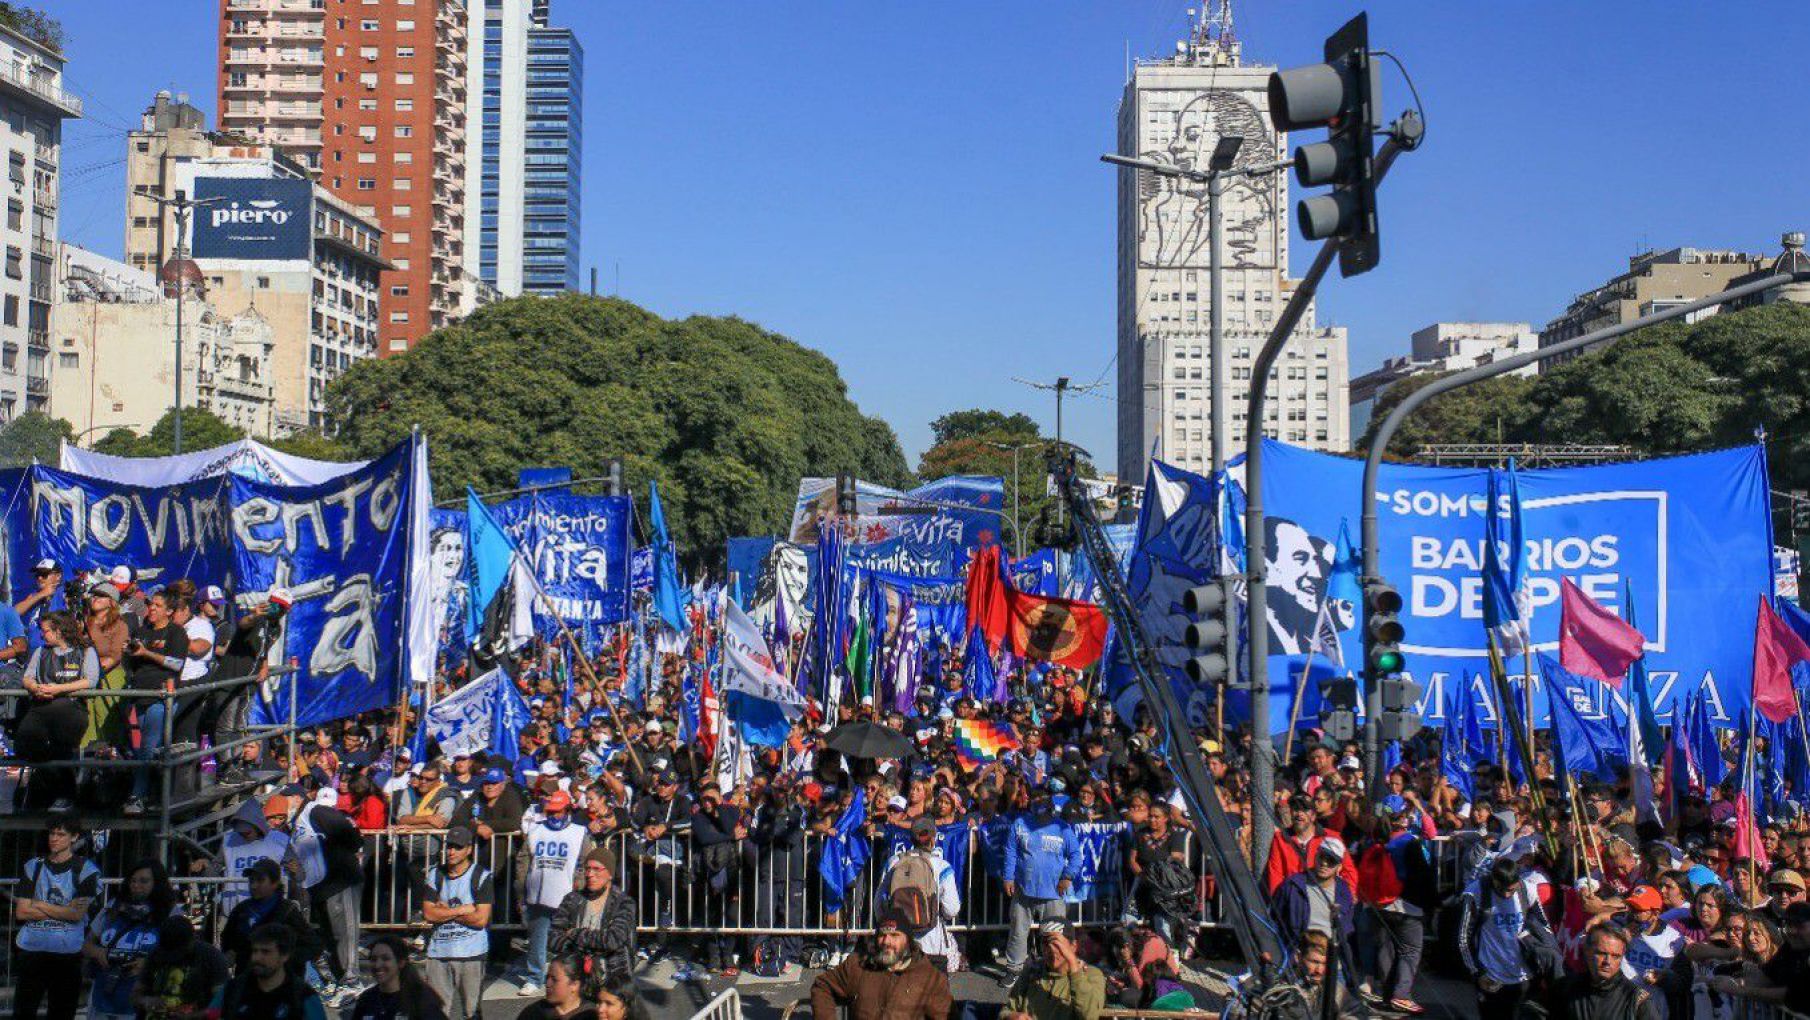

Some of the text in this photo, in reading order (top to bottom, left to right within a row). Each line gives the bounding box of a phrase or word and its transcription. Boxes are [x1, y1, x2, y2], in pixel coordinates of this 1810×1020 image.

[212, 202, 288, 227] piero
[1411, 572, 1619, 618] DE PE
[1389, 669, 1731, 722] MATNZA
[535, 840, 568, 857] CCC
[235, 855, 269, 869] CC
